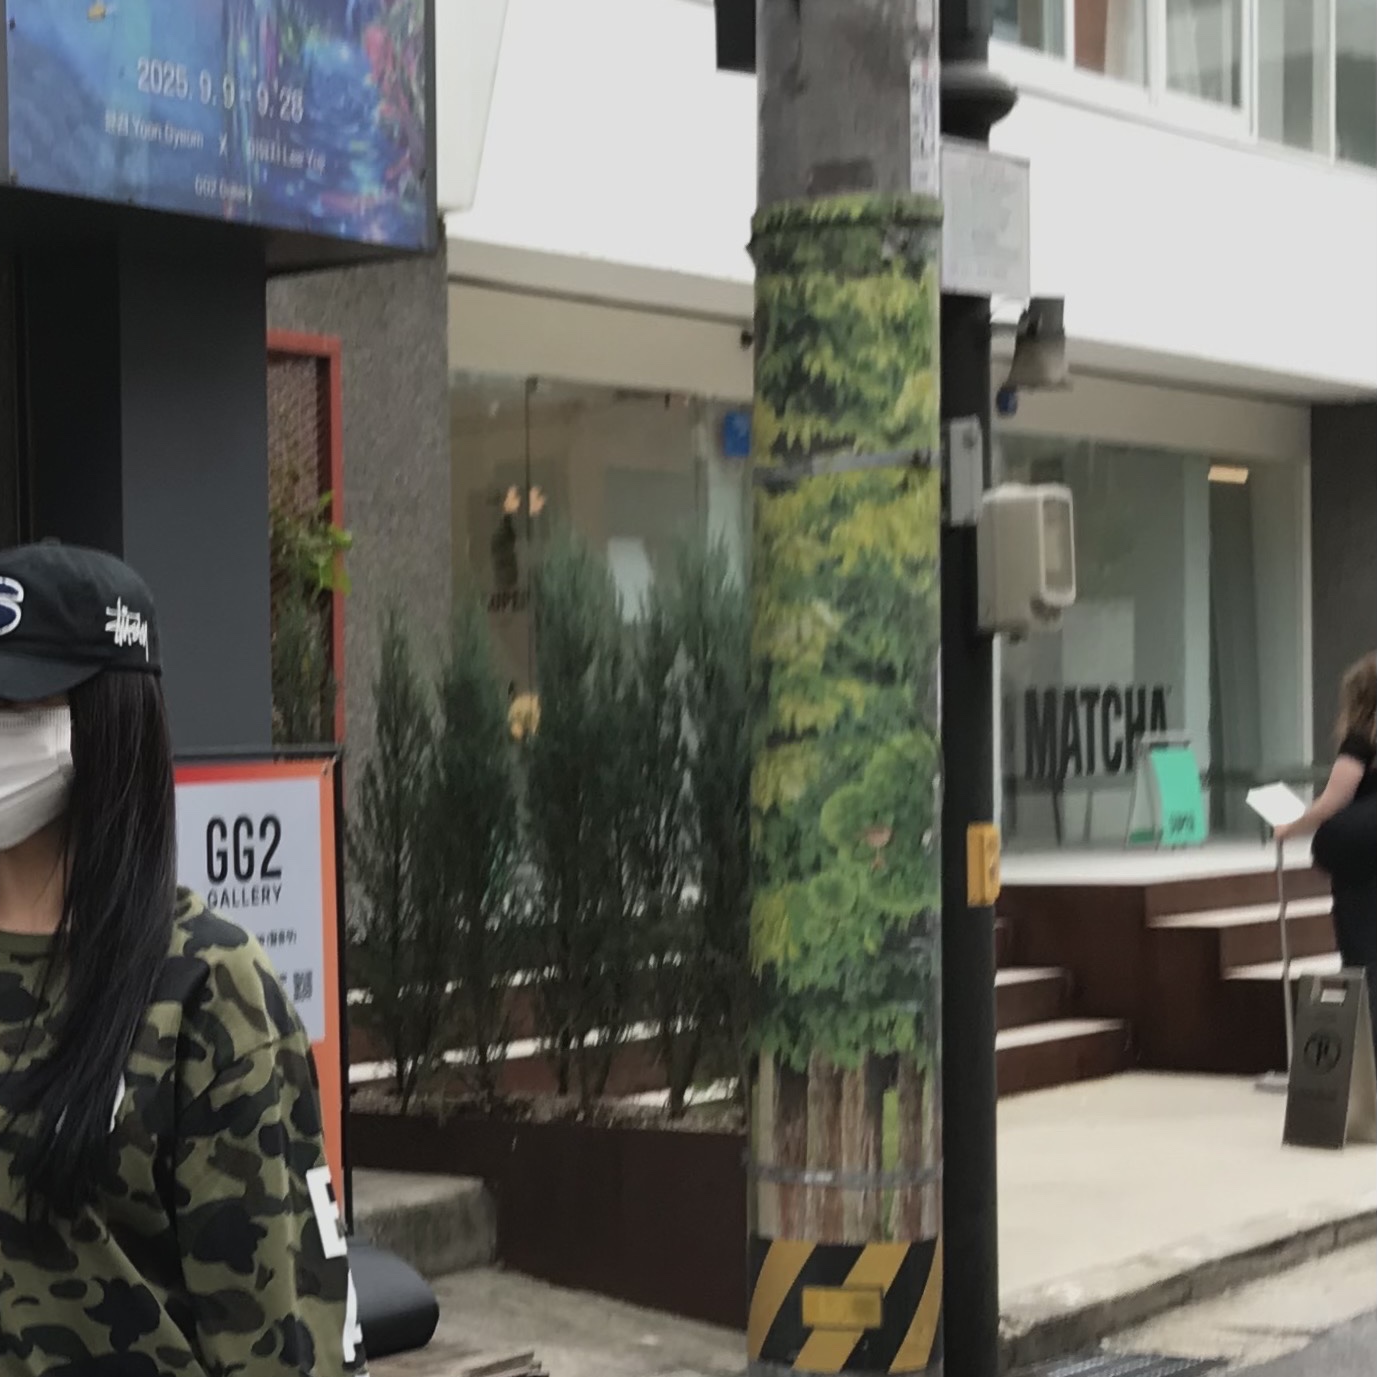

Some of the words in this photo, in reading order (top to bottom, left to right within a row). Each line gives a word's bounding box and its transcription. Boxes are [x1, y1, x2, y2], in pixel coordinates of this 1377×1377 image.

[1024, 683, 1167, 779] MATCHA
[206, 815, 282, 884] GG2
[207, 883, 282, 910] GALLERY
